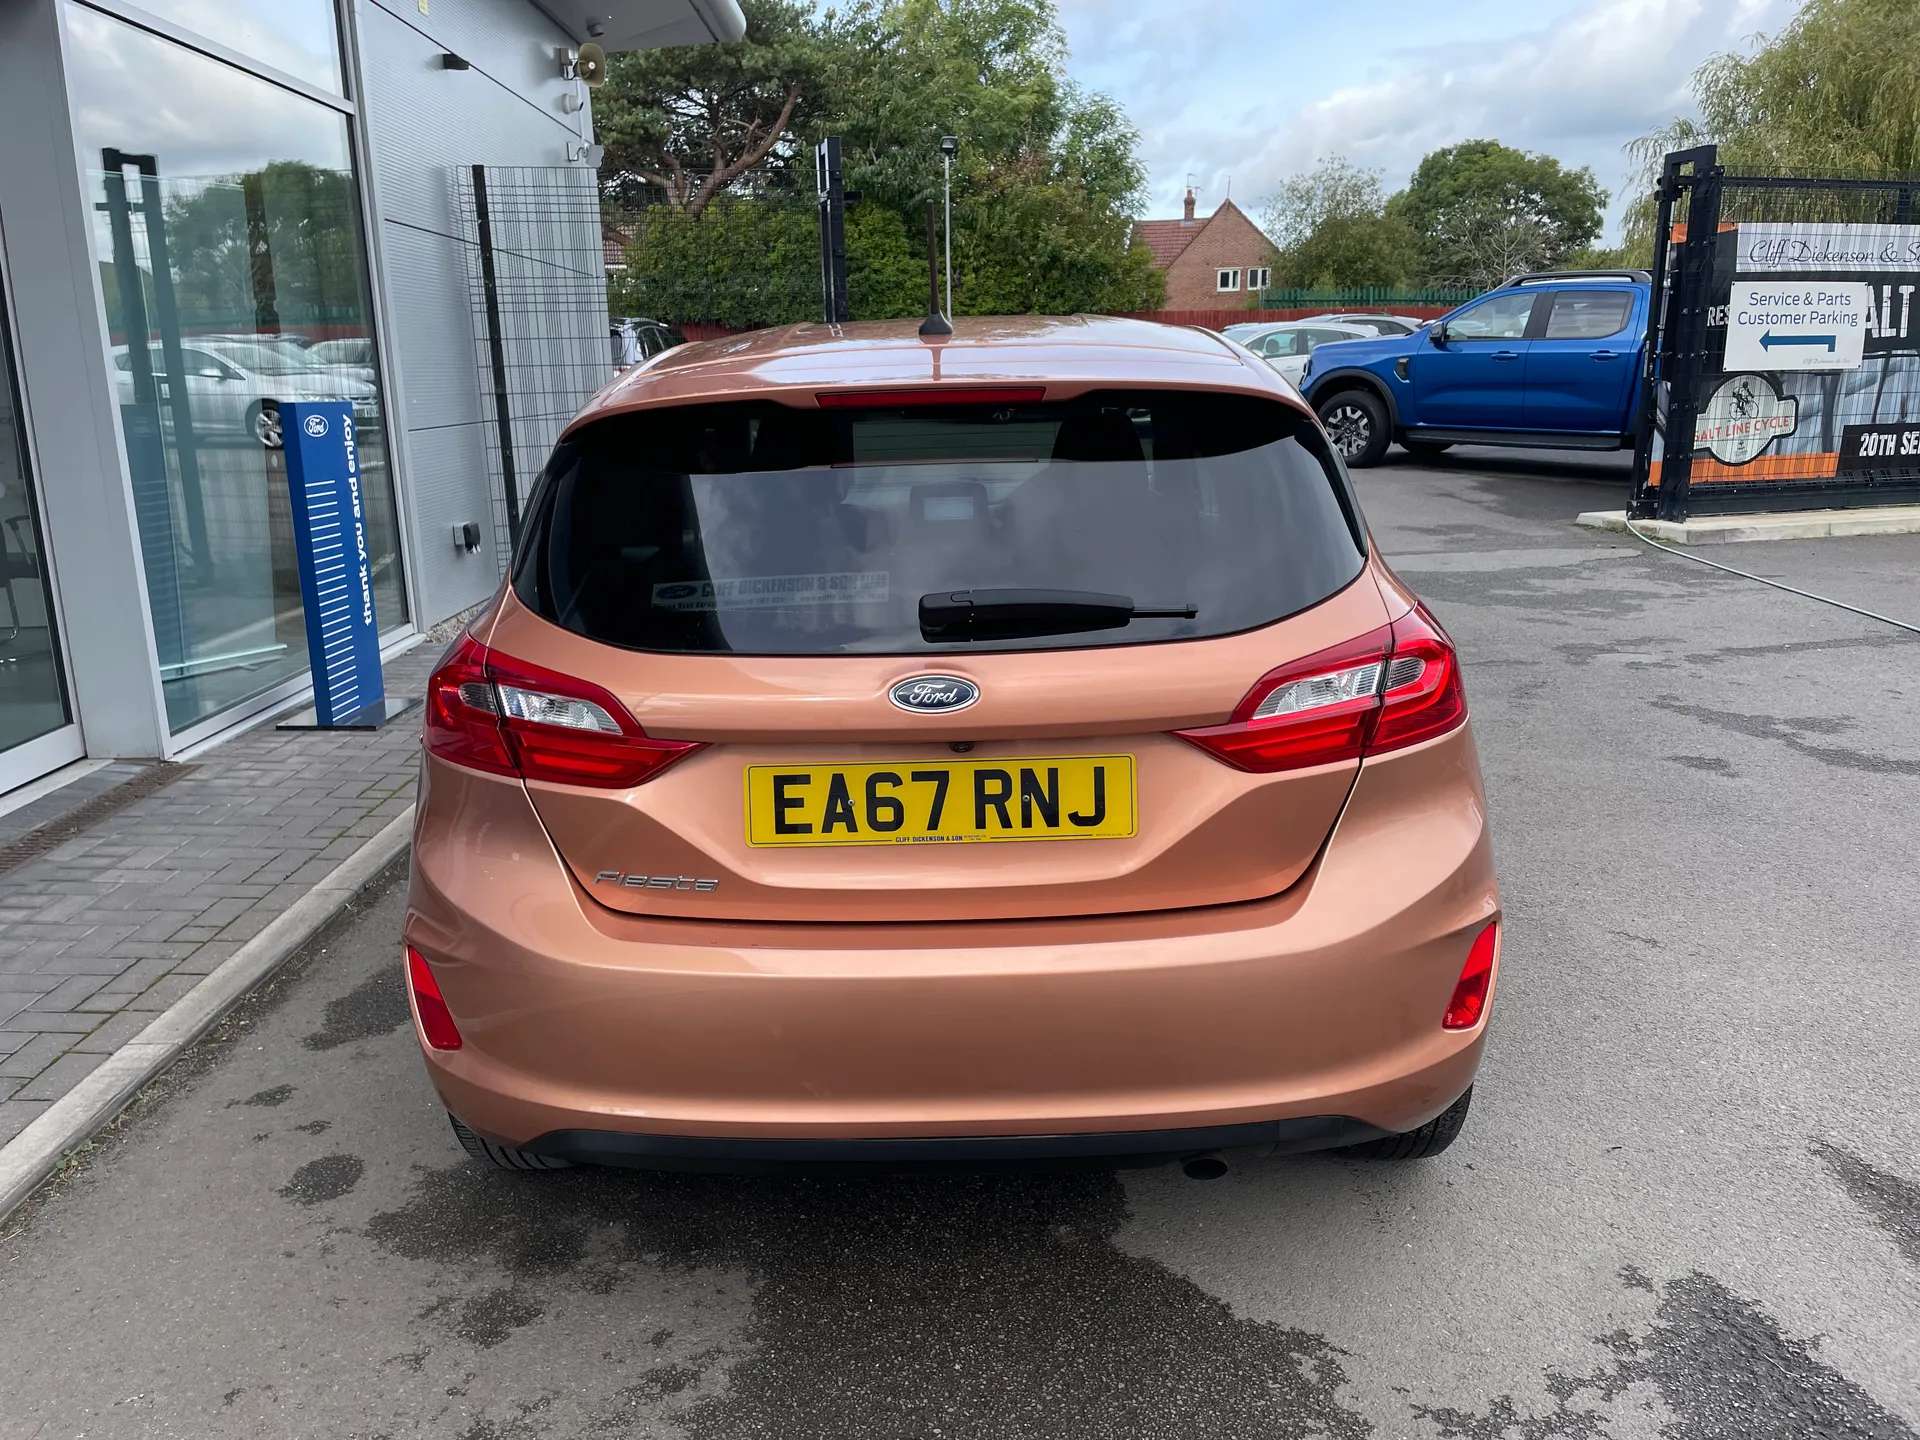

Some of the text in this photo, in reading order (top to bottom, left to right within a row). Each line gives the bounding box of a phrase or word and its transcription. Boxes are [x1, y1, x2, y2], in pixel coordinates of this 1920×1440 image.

[1749, 239, 1789, 268] Cliff
[1788, 240, 1874, 263] Dickenson
[1880, 242, 1900, 262] &
[1749, 292, 1851, 306] Service & Parts
[1738, 311, 1858, 327] Customer Parking
[1726, 422, 1751, 437] LINE
[1754, 416, 1790, 432] CYCLE
[1859, 432, 1897, 457] 20TH
[342, 413, 372, 626] thank you and enjoy
[909, 683, 957, 704] Ford
[773, 766, 1105, 834] EA67 RNJ
